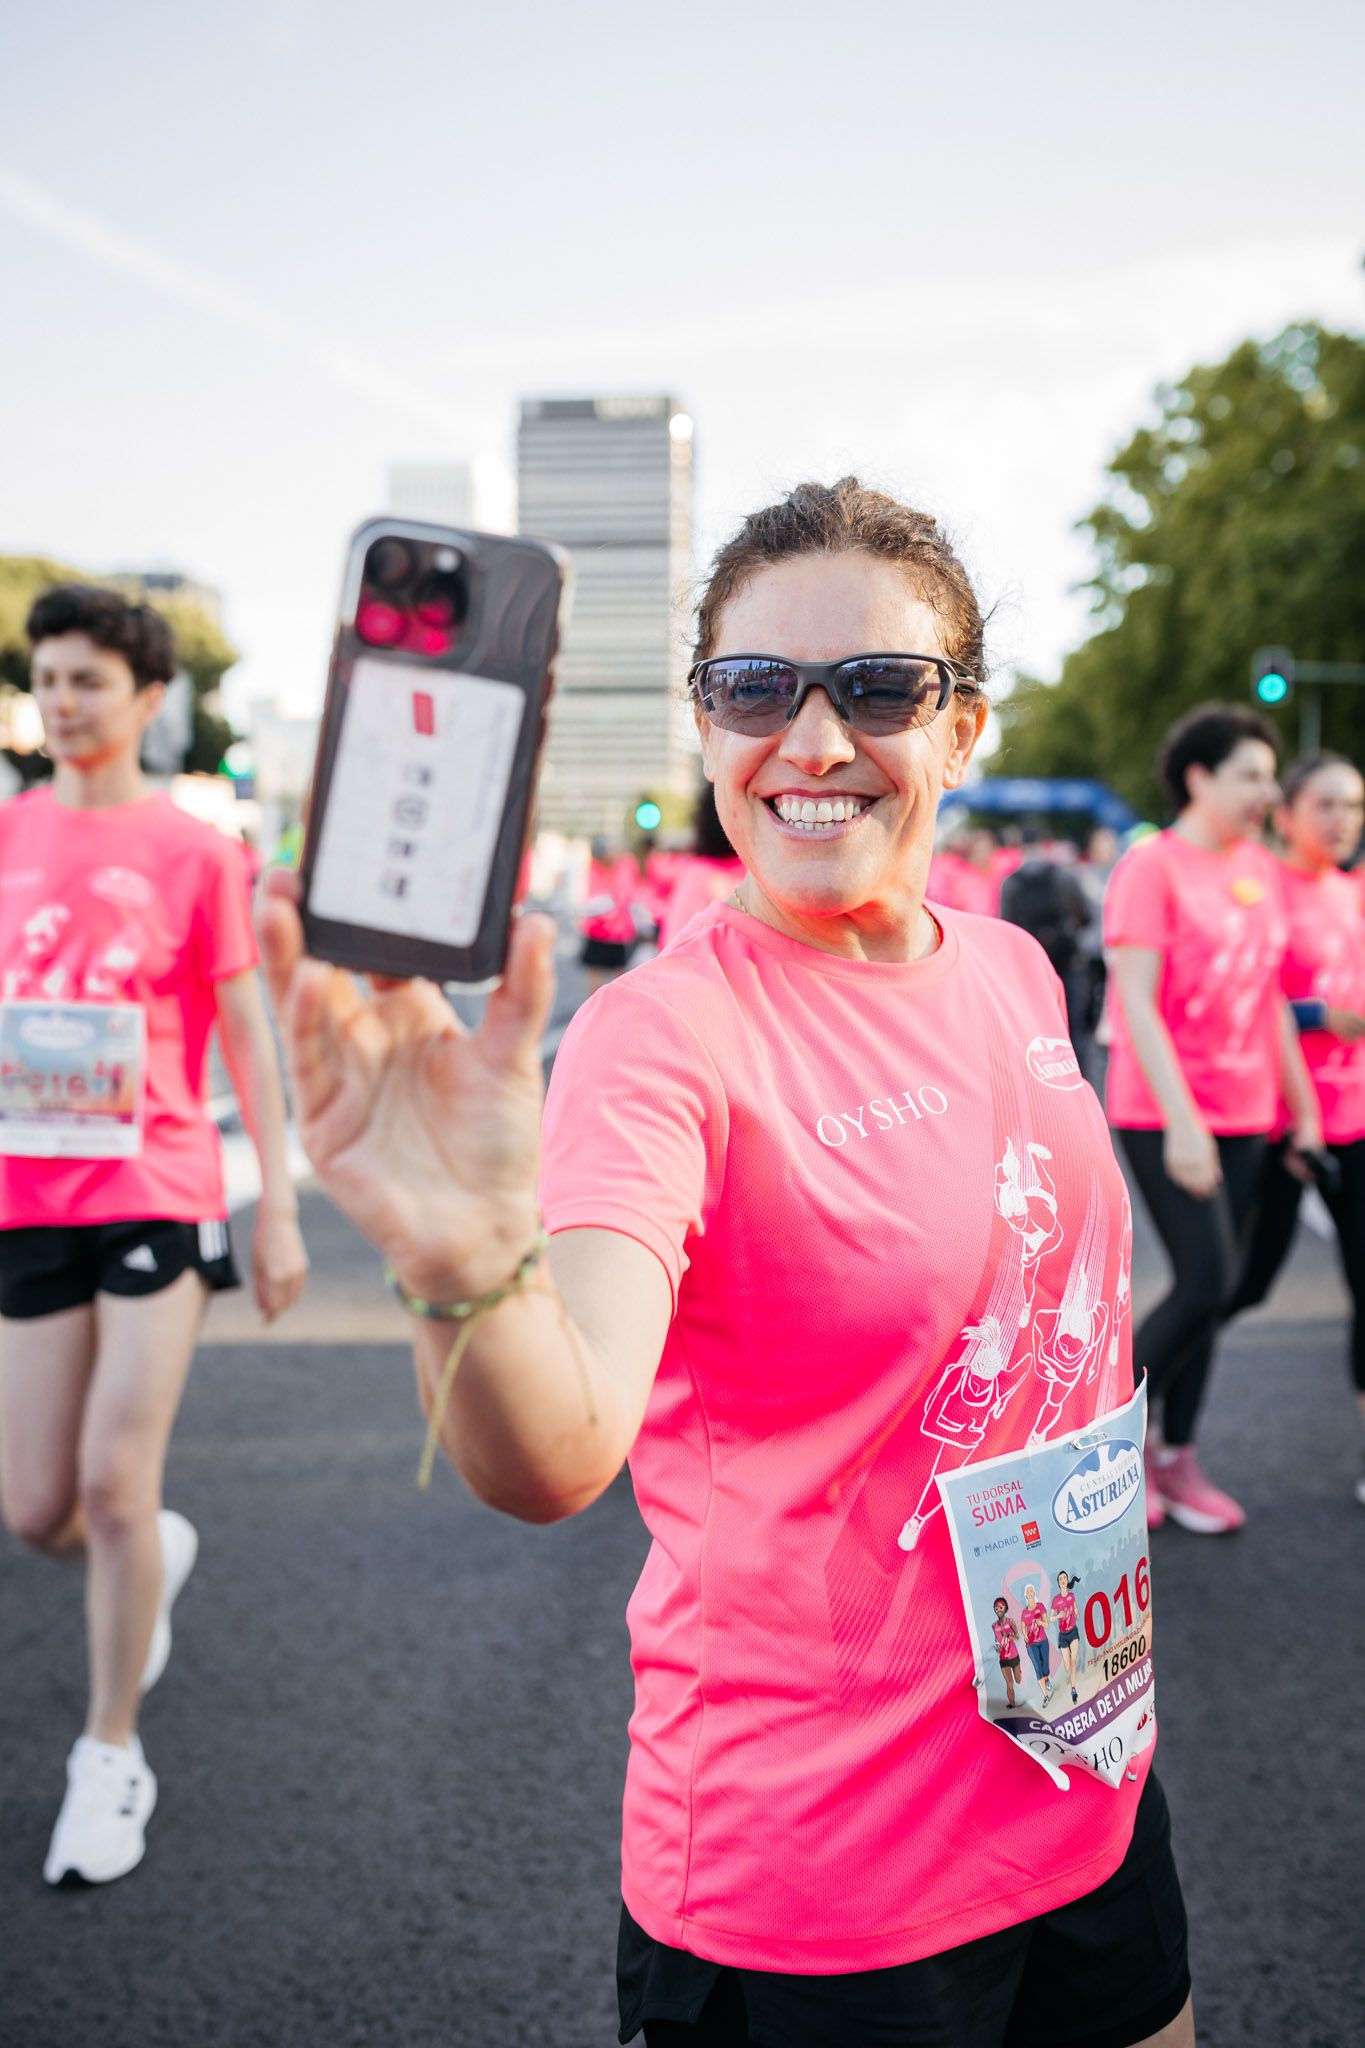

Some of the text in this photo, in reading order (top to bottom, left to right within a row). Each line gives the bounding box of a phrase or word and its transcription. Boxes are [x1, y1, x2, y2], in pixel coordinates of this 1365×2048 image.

[816, 1086, 948, 1147] OYSHO
[966, 1480, 1023, 1505] TU DORSAL
[972, 1493, 1027, 1527] SUMA
[1065, 1463, 1139, 1524] ASTURIANA
[984, 1535, 1019, 1552] MADRID
[1084, 1556, 1149, 1648] 016
[1102, 1634, 1146, 1682] 18600
[1029, 1707, 1097, 1740] CARRERA
[1096, 1694, 1114, 1719] DE
[1112, 1684, 1126, 1706] LA
